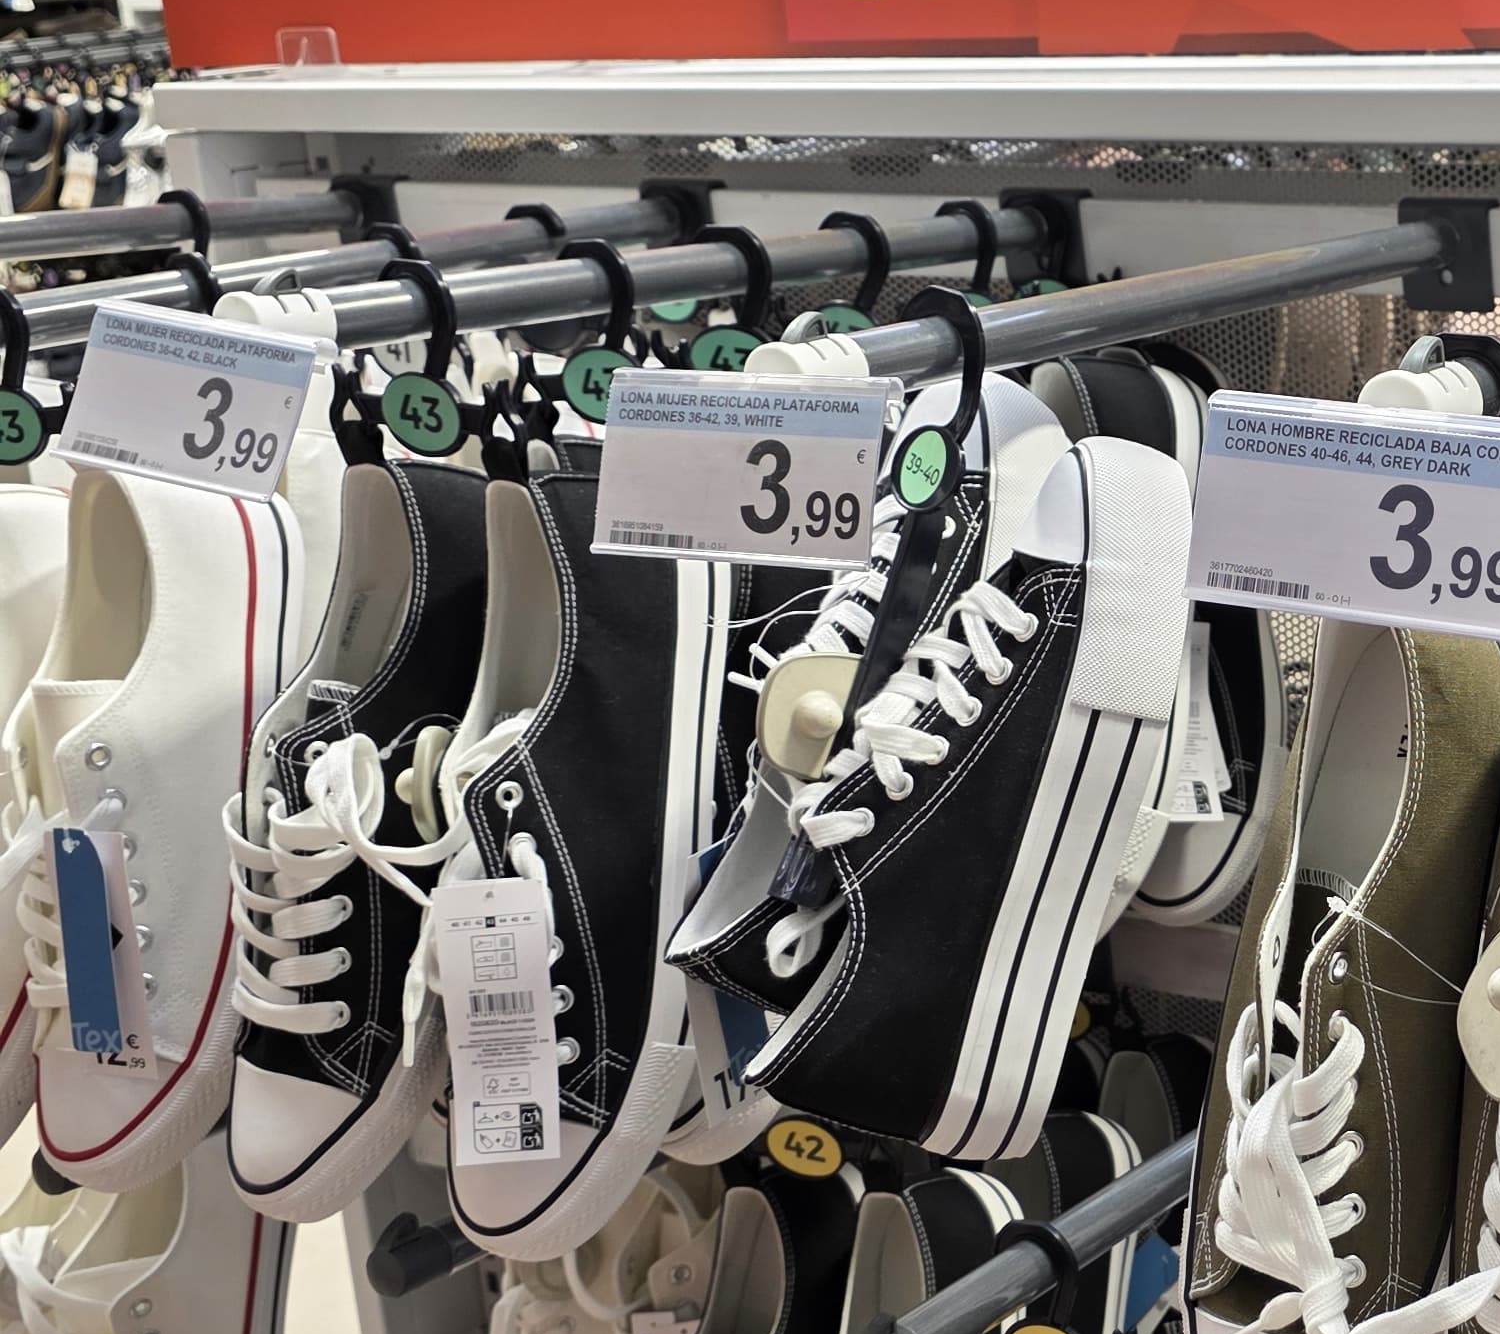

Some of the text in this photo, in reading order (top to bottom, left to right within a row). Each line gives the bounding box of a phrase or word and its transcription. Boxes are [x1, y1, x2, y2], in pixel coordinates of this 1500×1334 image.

[103, 333, 156, 353] CORDONES
[202, 353, 238, 369] BLACK
[106, 318, 296, 365] LONA MUJER RECICLADA PLATAFORMA
[284, 396, 294, 410] €
[400, 394, 443, 433] 43
[618, 408, 784, 428] CORDONES 36-42, 39, WHITE
[620, 391, 860, 414] LONA MUJER RECICLADA PLATAFORMA
[0, 410, 25, 444] 3
[1227, 417, 1268, 435] LONA
[1270, 421, 1335, 443] HOMBRE
[1339, 429, 1425, 453] RECICLADA
[1431, 439, 1472, 458] BAJA
[856, 449, 867, 464] €
[905, 450, 941, 487] 39-40
[1224, 436, 1472, 478] CORDONES 40-46, 44, GREY DARK
[1209, 560, 1274, 578] 3617702460420
[72, 1022, 120, 1053] Tex
[126, 1033, 140, 1049] €
[784, 1132, 827, 1164] 42
